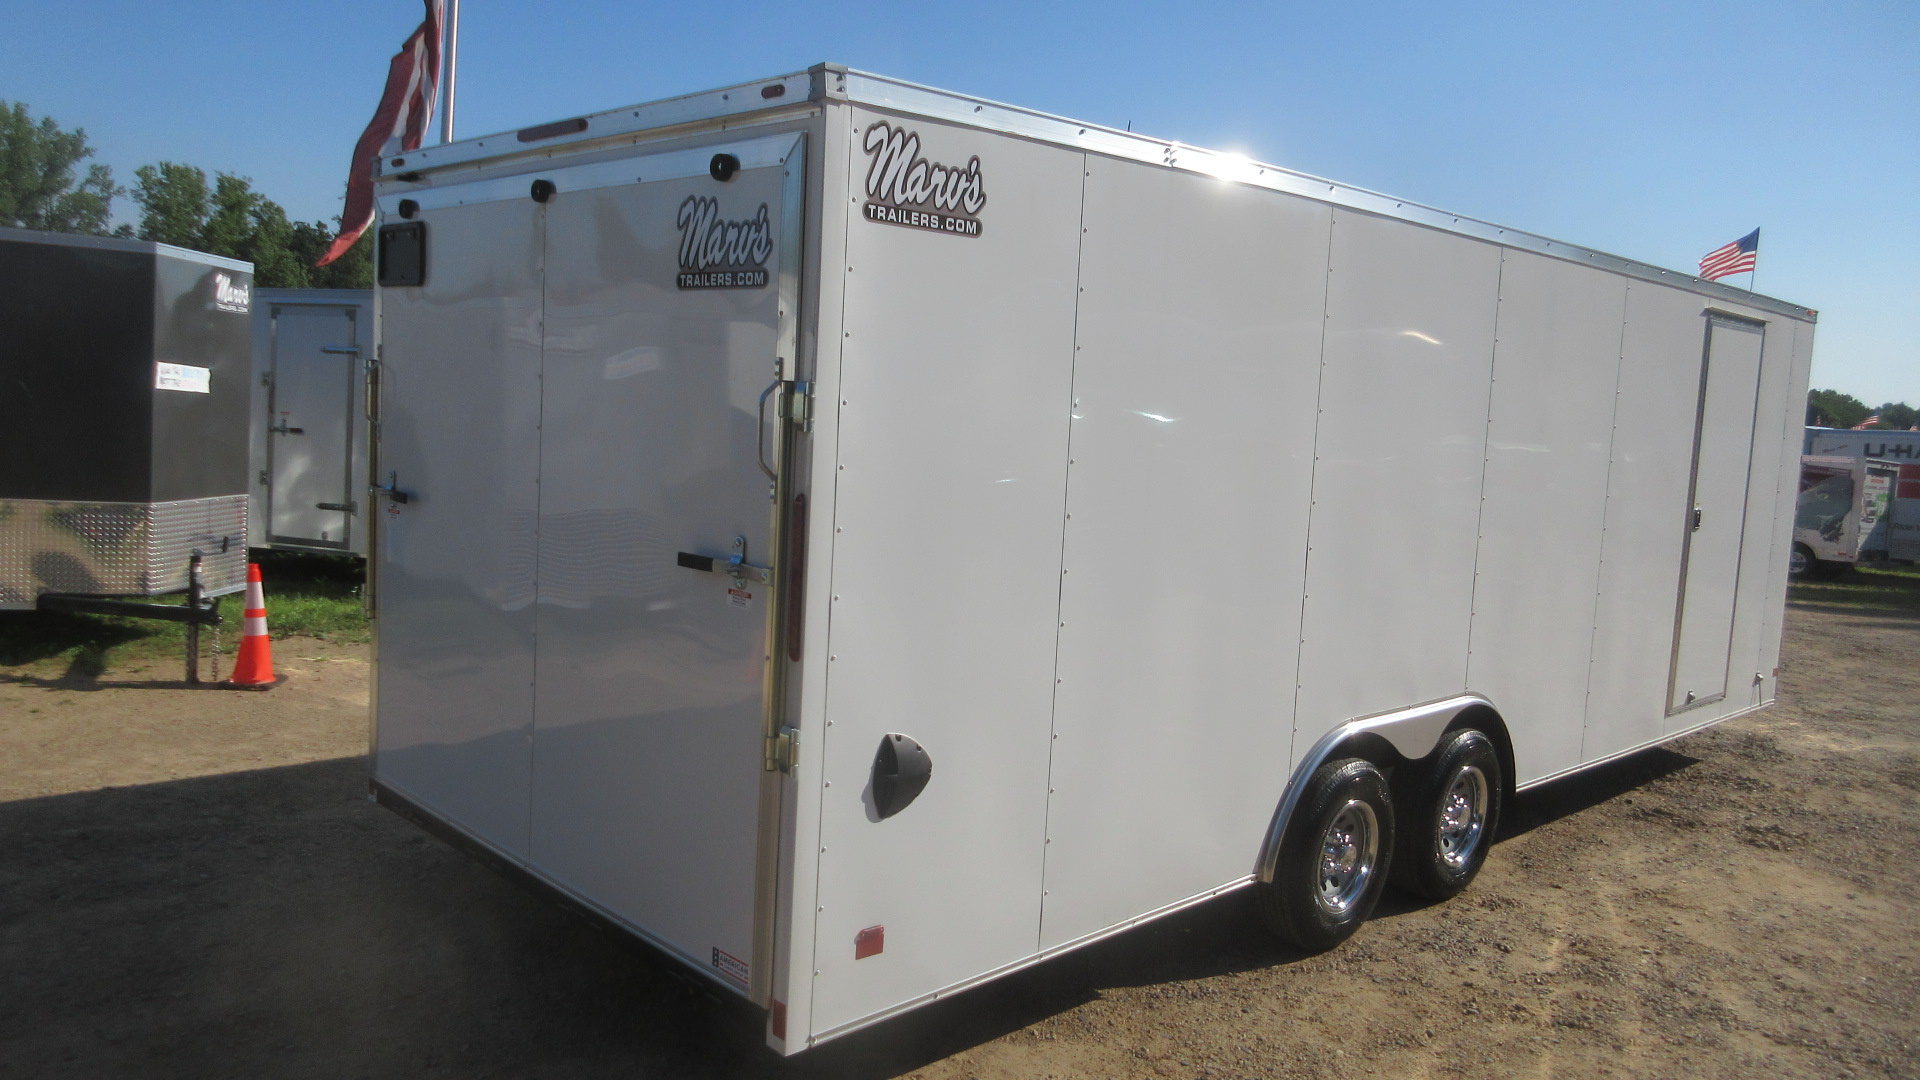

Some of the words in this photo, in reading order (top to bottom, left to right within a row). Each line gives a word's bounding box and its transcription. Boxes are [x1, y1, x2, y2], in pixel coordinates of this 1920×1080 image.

[864, 121, 986, 215] Marv's
[678, 195, 773, 271] Marv's
[868, 204, 977, 235] TRAILERS.COM
[680, 272, 764, 287] TRAILERS.COM
